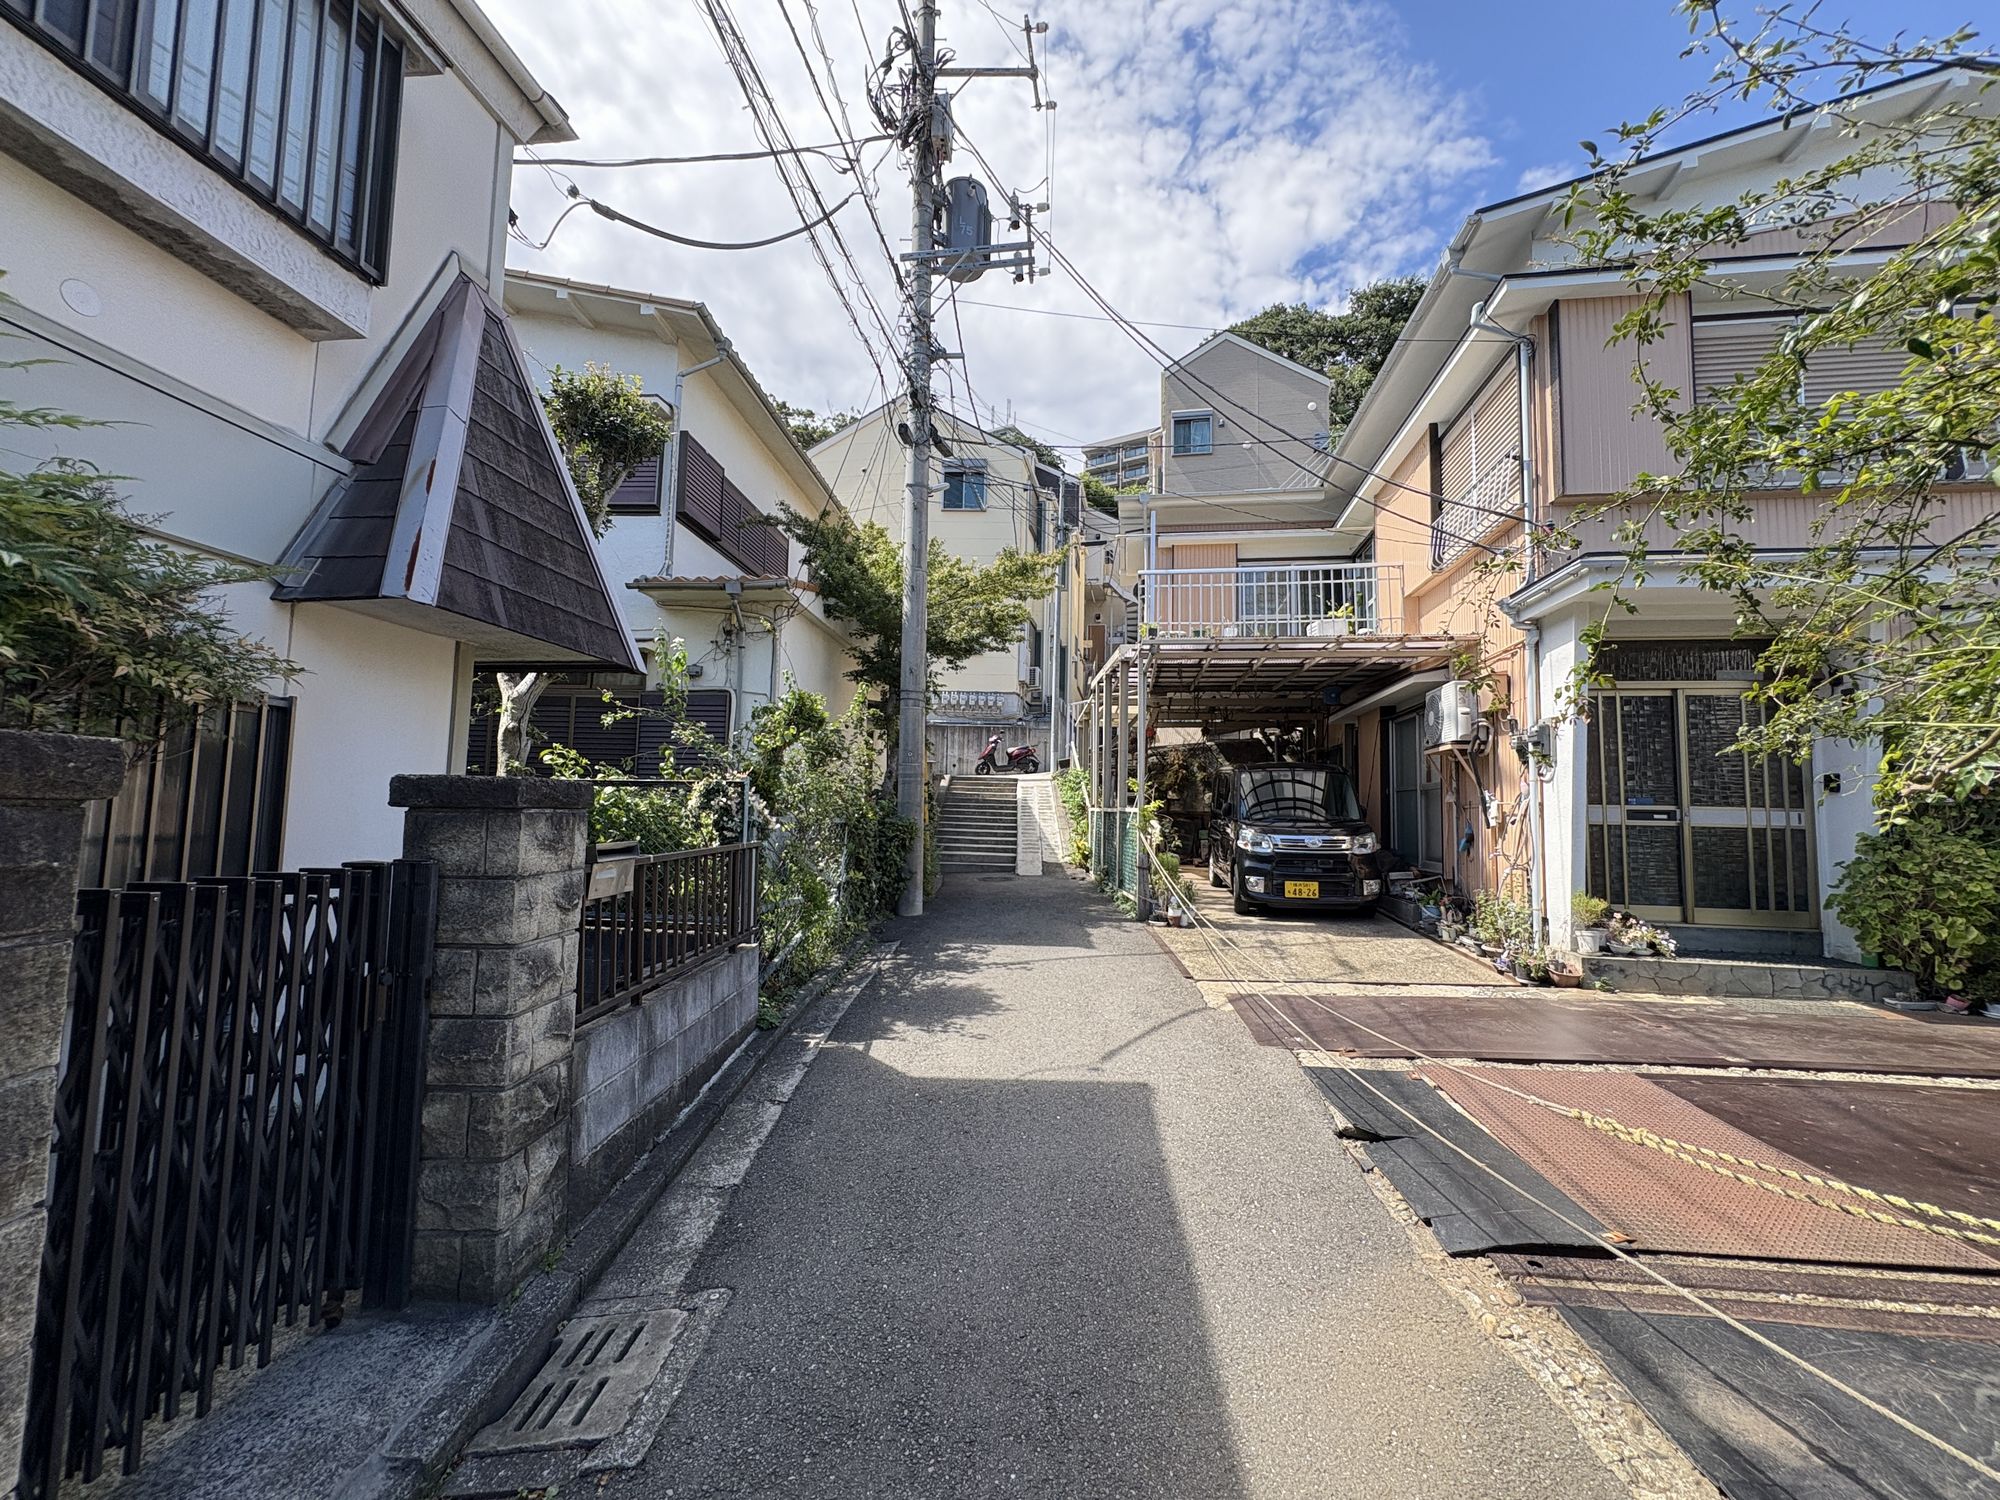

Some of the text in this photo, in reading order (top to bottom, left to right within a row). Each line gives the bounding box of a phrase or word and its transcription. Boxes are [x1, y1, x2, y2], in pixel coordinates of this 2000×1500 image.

[960, 216, 966, 224] L
[960, 224, 972, 236] 75
[1292, 888, 1317, 896] 48-26
